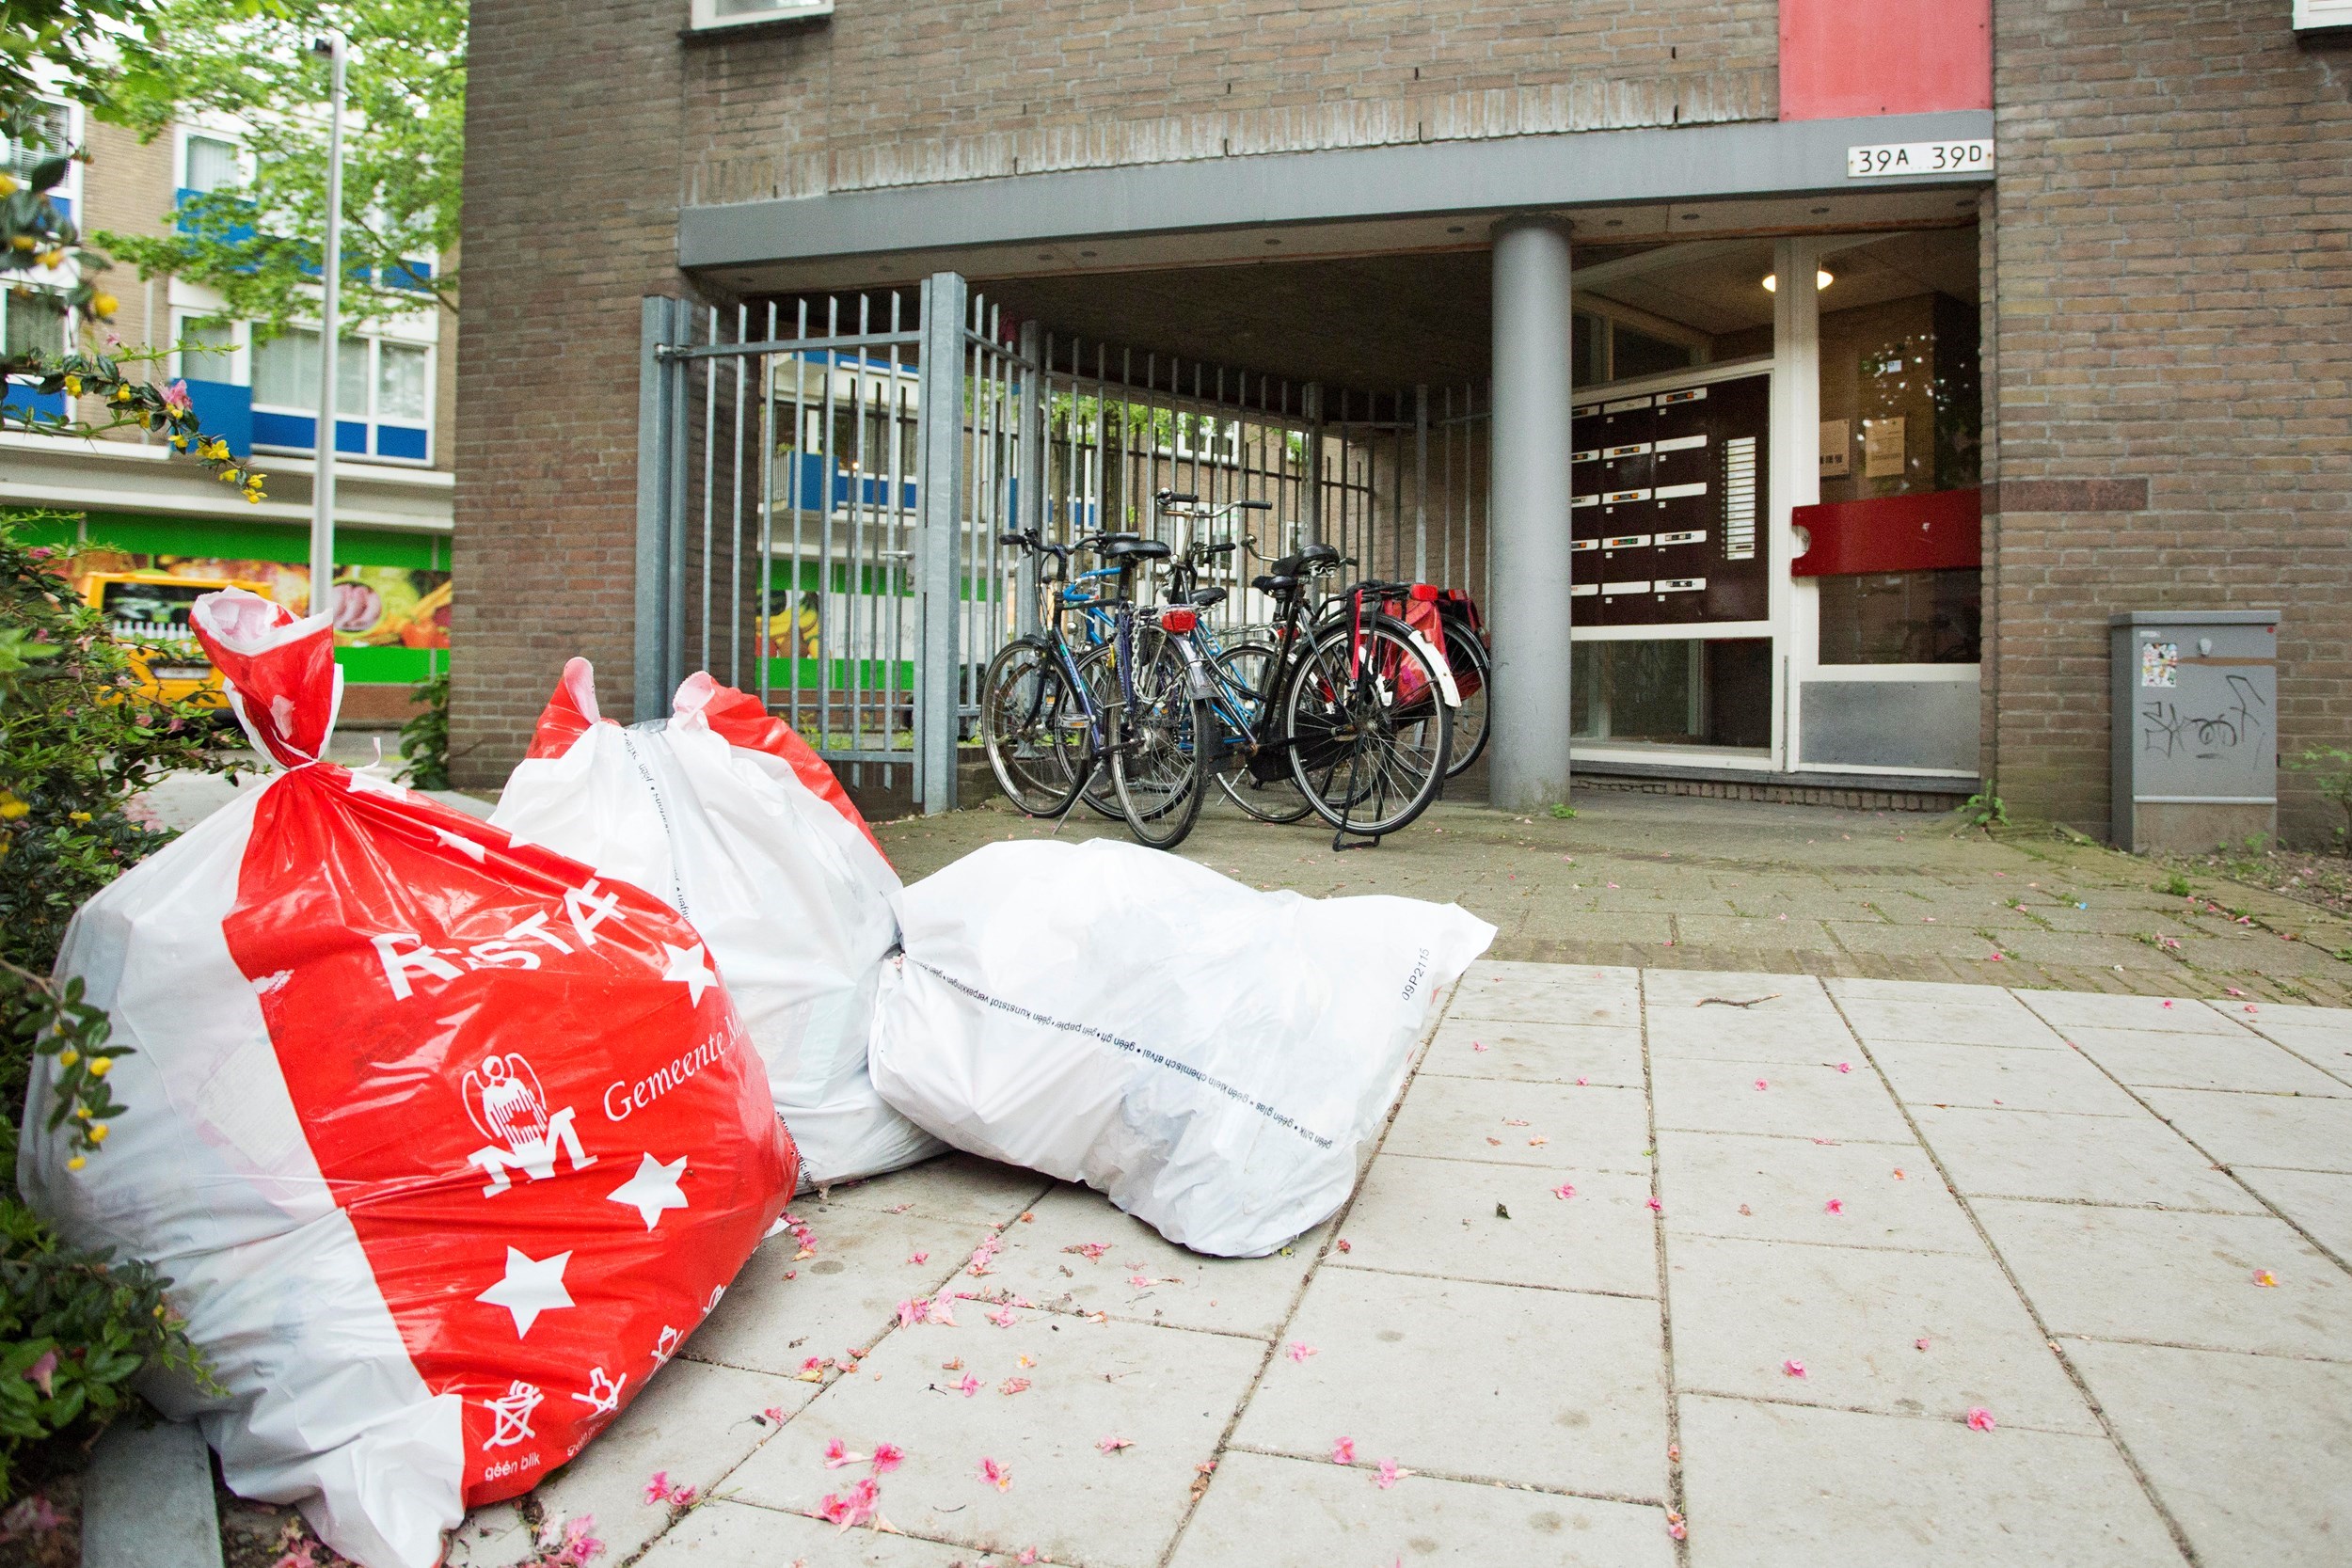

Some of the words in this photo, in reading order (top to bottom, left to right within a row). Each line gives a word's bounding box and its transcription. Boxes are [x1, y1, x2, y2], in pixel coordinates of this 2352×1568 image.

[1858, 148, 1909, 173] 39A
[1931, 145, 1982, 169] 39D
[370, 878, 627, 1001] RSTA
[946, 975, 989, 1003] verpakkingen
[989, 997, 1032, 1020] kunststof
[1055, 1021, 1082, 1032] papier
[1100, 1032, 1113, 1043] gft
[1113, 1037, 1136, 1052] géén
[1142, 1049, 1164, 1064] afval
[603, 1031, 726, 1122] Gemeente
[1165, 1058, 1208, 1082] chemisch
[1208, 1076, 1229, 1093] klein
[1255, 1101, 1274, 1117] glas
[520, 1451, 541, 1470] blik
